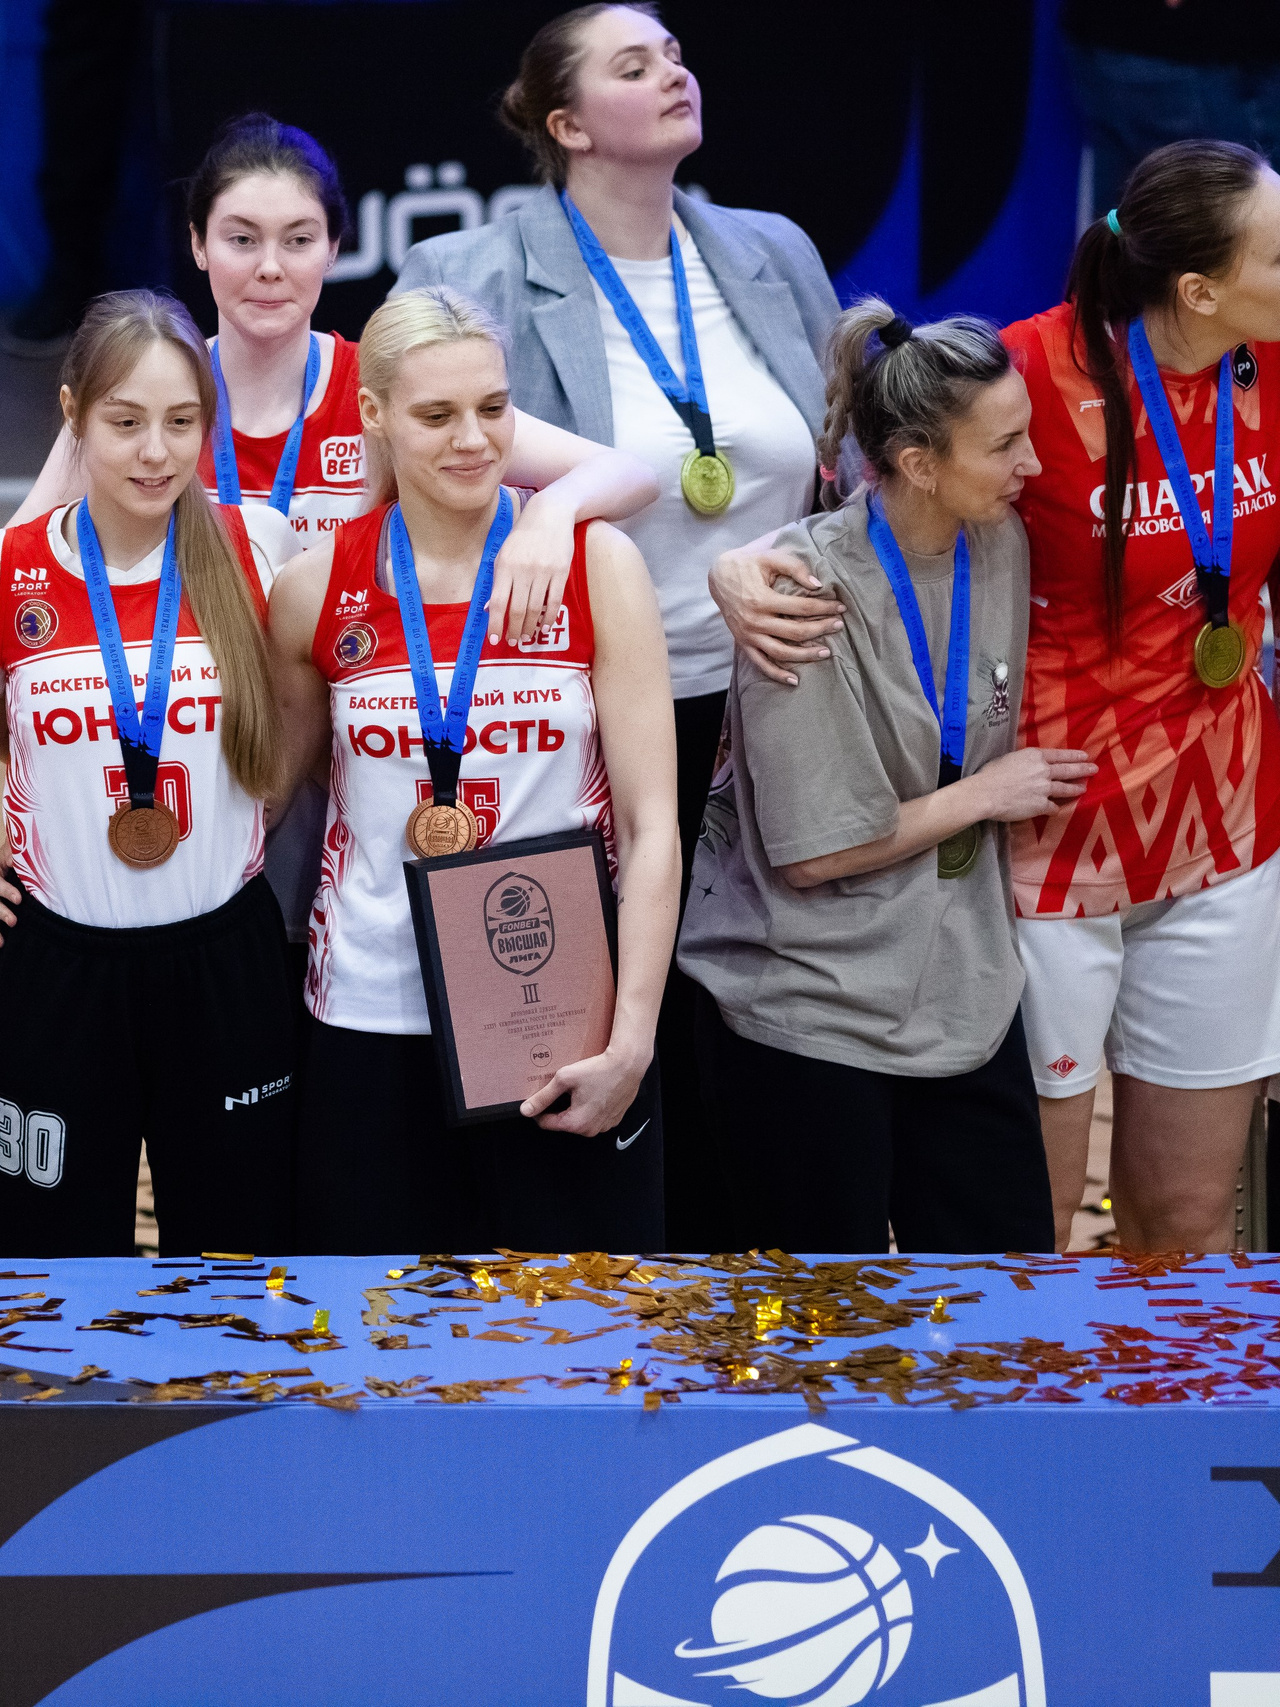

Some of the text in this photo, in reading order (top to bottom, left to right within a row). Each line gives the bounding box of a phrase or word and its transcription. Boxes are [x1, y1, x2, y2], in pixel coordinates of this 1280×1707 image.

[324, 440, 362, 457] FON
[1158, 421, 1177, 454] РОССИИ
[326, 457, 363, 475] BET
[1091, 490, 1277, 538] МСКОВСЯ БЛАСТЬ
[484, 541, 500, 575] РОССИИ
[11, 582, 50, 592] SPORT
[159, 586, 174, 634] ЧЕМПИОНАТ
[471, 579, 490, 629] ЧЕМПИОНАТ
[84, 540, 102, 587] ЧЕМПИОНАТ
[95, 591, 110, 623] РОССИИ
[107, 643, 127, 697] БАСКЕТБОЛУ
[395, 539, 412, 585] ЧЕМПИОНАТ
[405, 589, 418, 622] РОССИИ
[415, 642, 432, 697] БАСКЕТБОЛУ
[155, 638, 167, 670] FONBET
[461, 633, 476, 667] FONBET
[201, 666, 220, 680] КЛ
[455, 671, 468, 695] XXXIV
[151, 675, 162, 701] XXXIV
[514, 689, 562, 704] КЛУБ
[32, 696, 222, 746] ЮНСТ
[502, 919, 537, 932] FONBET
[498, 931, 548, 955] ВЫСШАЯ
[509, 952, 541, 964] ЛИГА
[521, 983, 541, 1004] III
[533, 1051, 550, 1060] РФБ
[261, 1072, 293, 1094] SPOR
[261, 1083, 292, 1099] LABORATO
